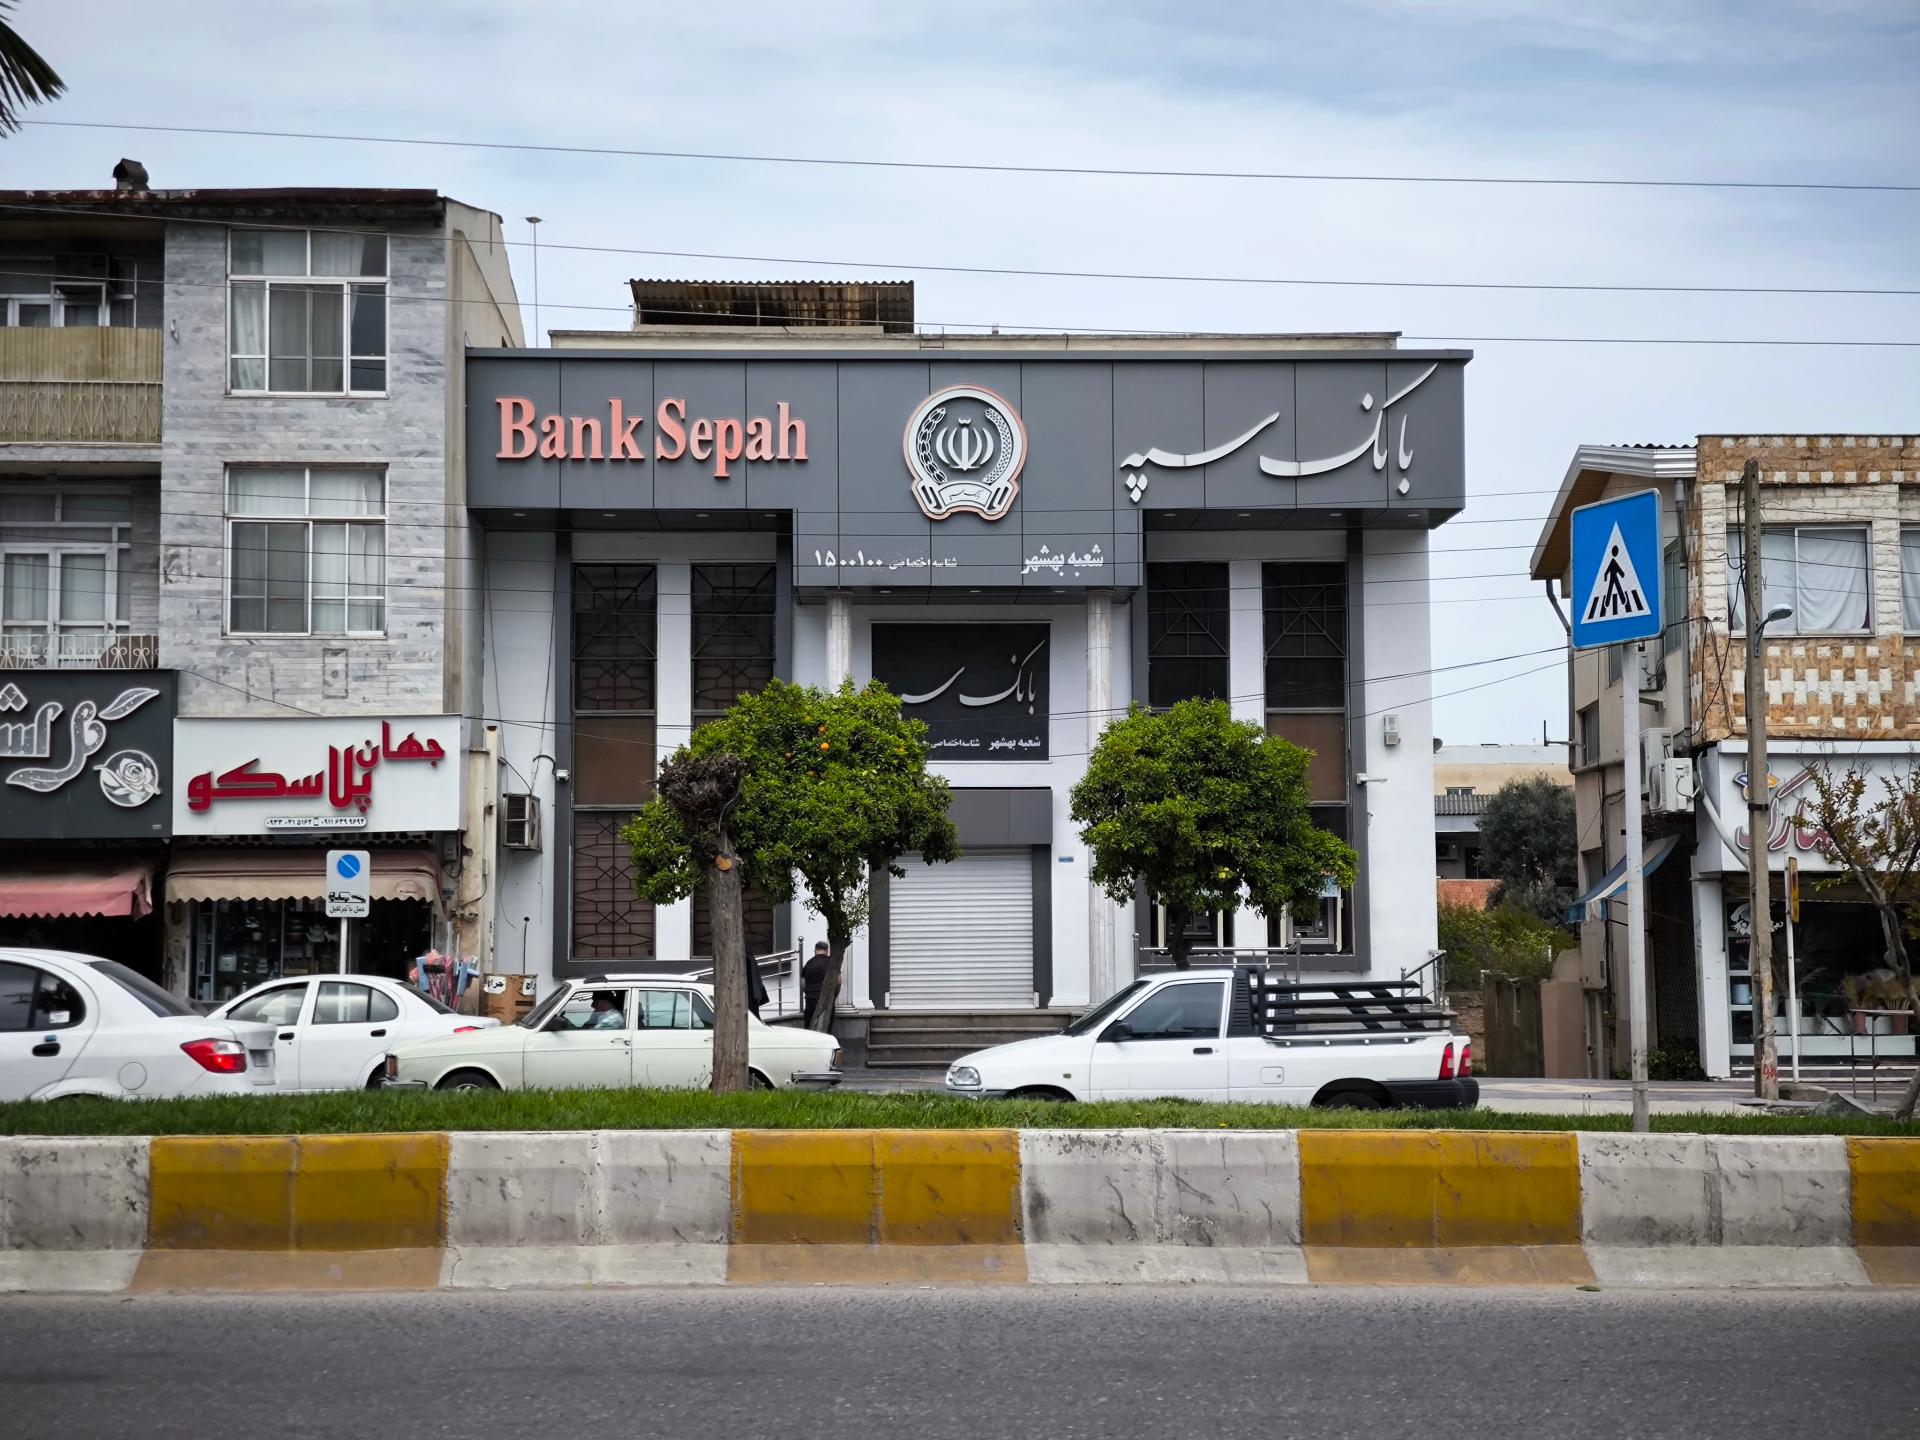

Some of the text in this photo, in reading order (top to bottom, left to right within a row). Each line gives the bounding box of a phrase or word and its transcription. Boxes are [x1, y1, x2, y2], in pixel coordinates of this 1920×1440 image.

[496, 397, 809, 478] Bank Sepah
[1120, 362, 1438, 503] بانک سپه
[815, 550, 958, 570] شناسه اختصاصی ۱۵۰۰۱۰۰
[1021, 544, 1104, 577] شعبه بهشهر
[959, 640, 1046, 715] بانک
[356, 720, 445, 770] جهان
[988, 737, 1016, 750] بهشهر
[1018, 736, 1041, 750] شعبه
[187, 744, 374, 814] پلاسکو
